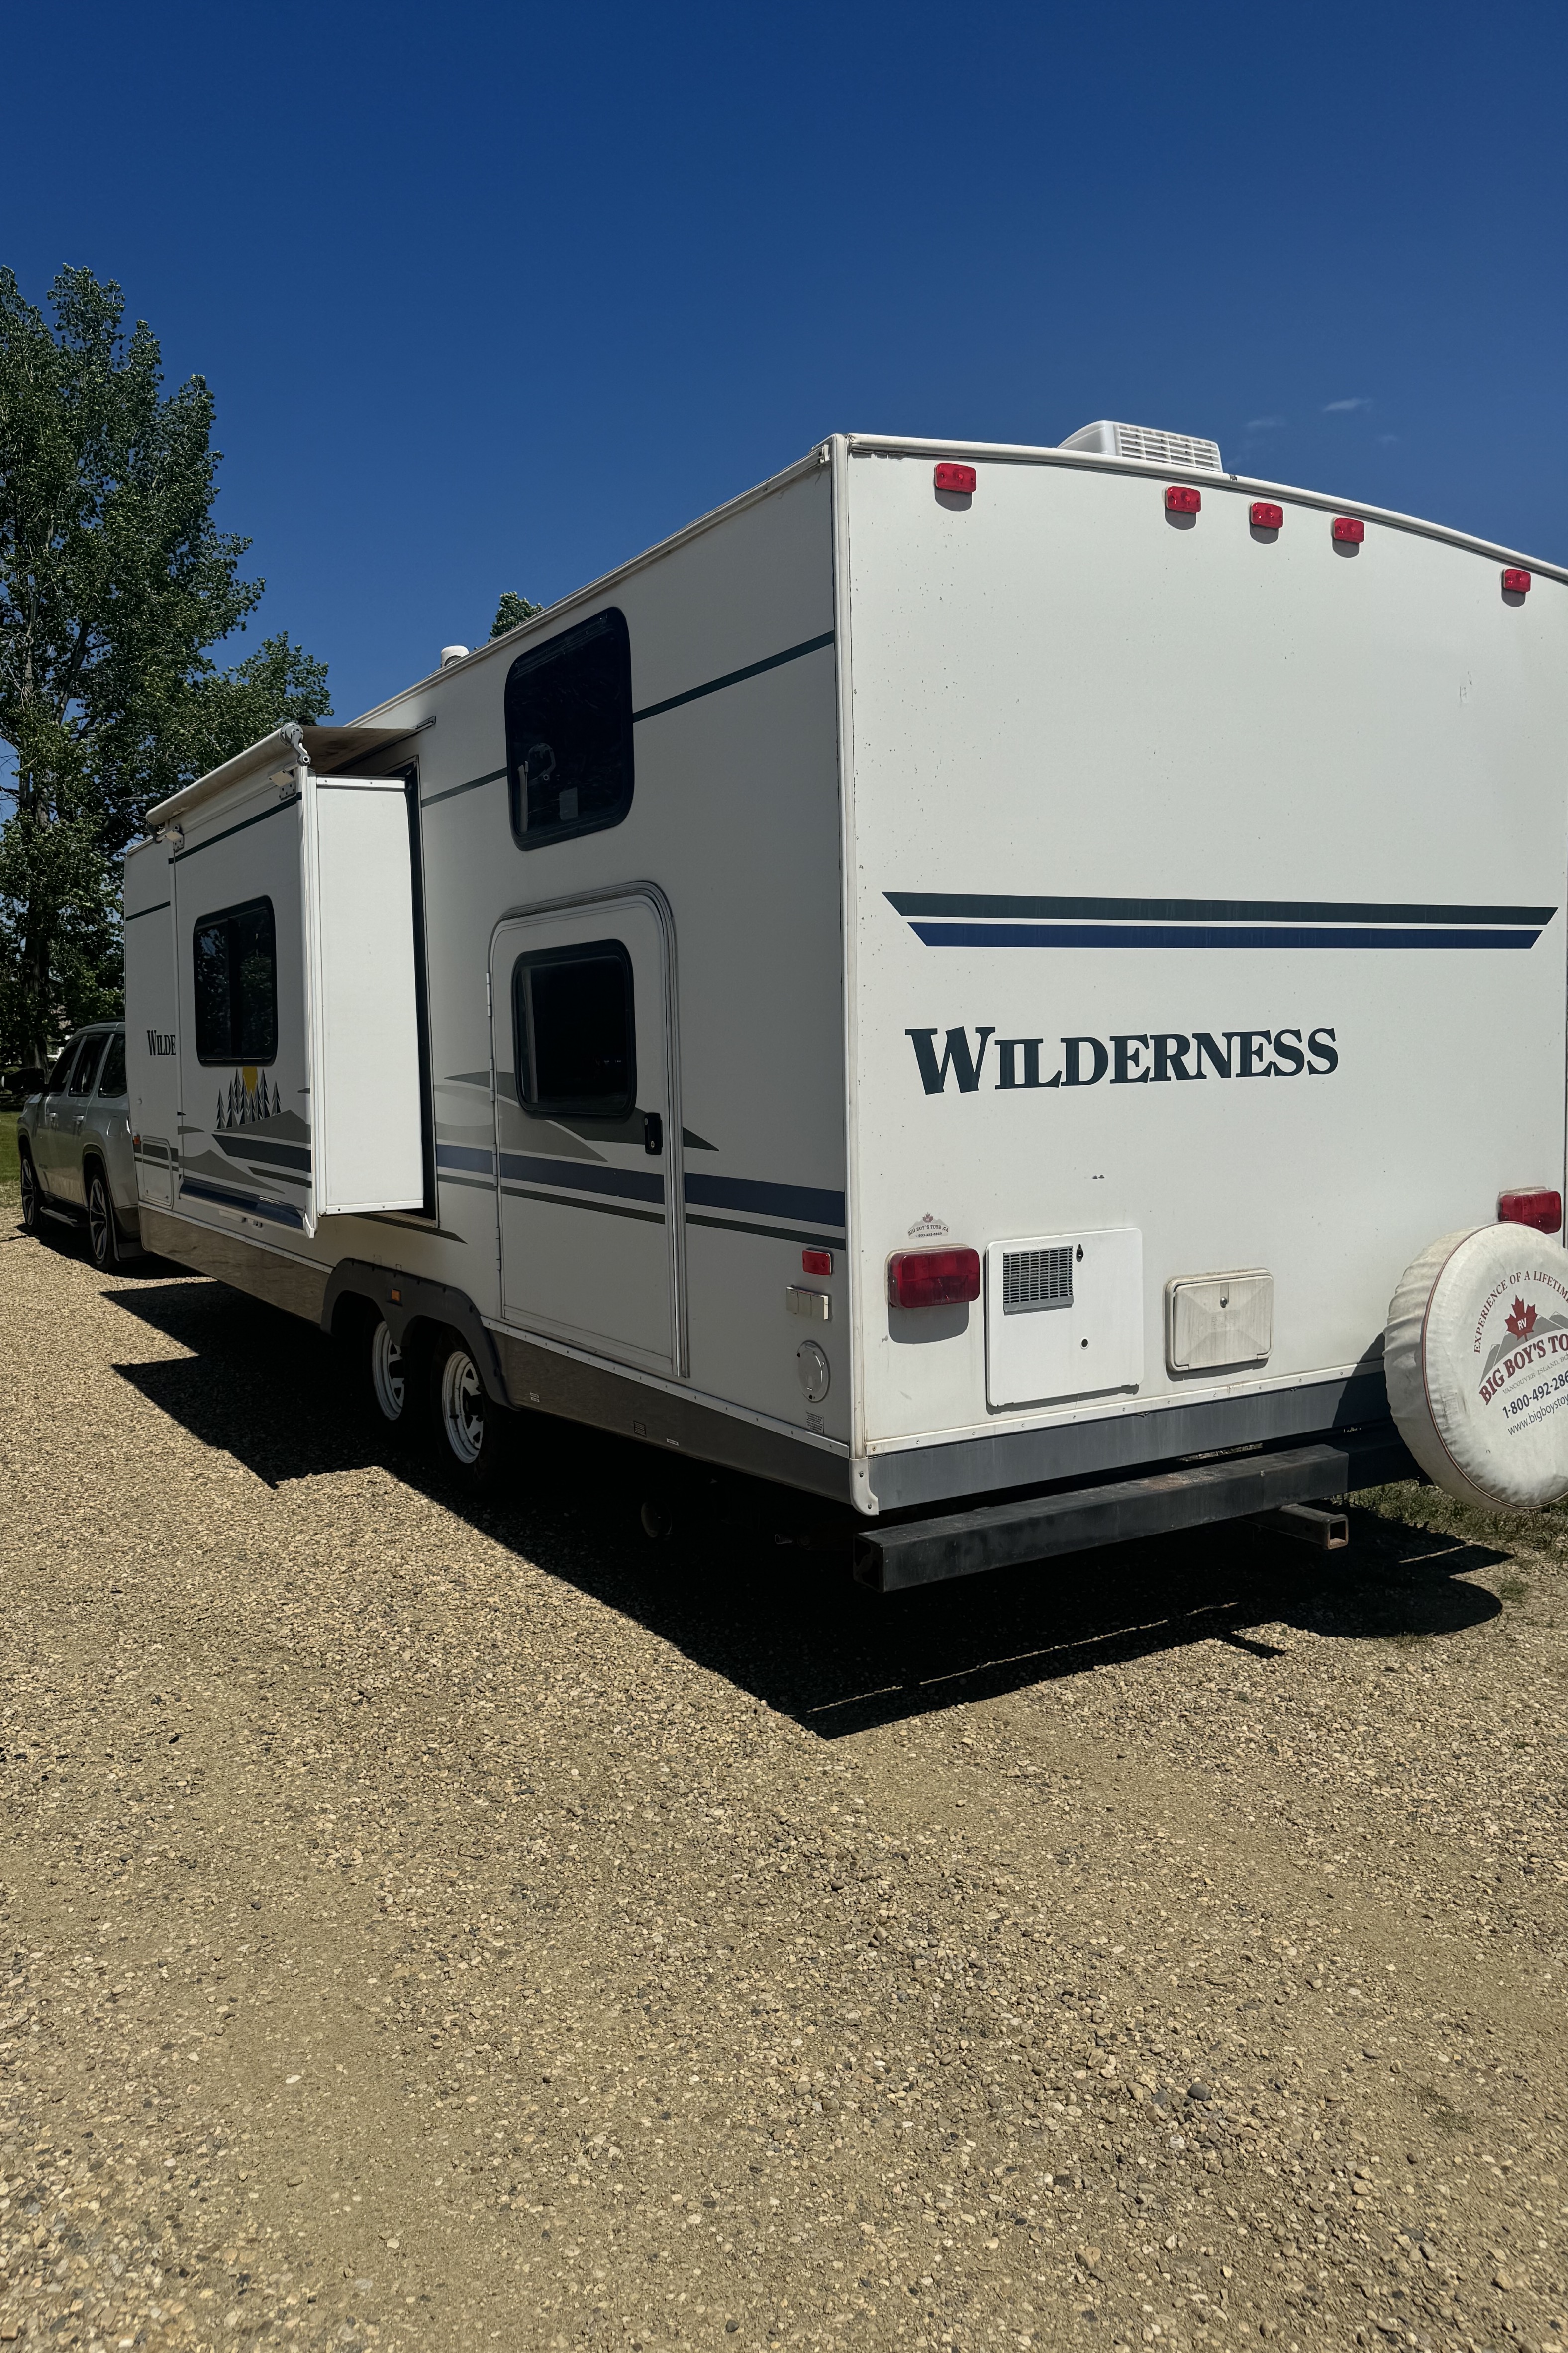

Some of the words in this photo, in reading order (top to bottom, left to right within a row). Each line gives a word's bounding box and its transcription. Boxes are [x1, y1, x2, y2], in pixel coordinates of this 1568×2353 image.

[904, 1026, 1339, 1095] WILDERNESS
[1474, 1280, 1508, 1354] EXPERIENCE
[1510, 1272, 1522, 1285] OF
[1524, 1270, 1531, 1280] A
[1517, 1317, 1527, 1330] RV
[1479, 1367, 1505, 1406] BIG
[1503, 1339, 1547, 1378] BOY'S
[1502, 1372, 1536, 1395] VANCOUVER
